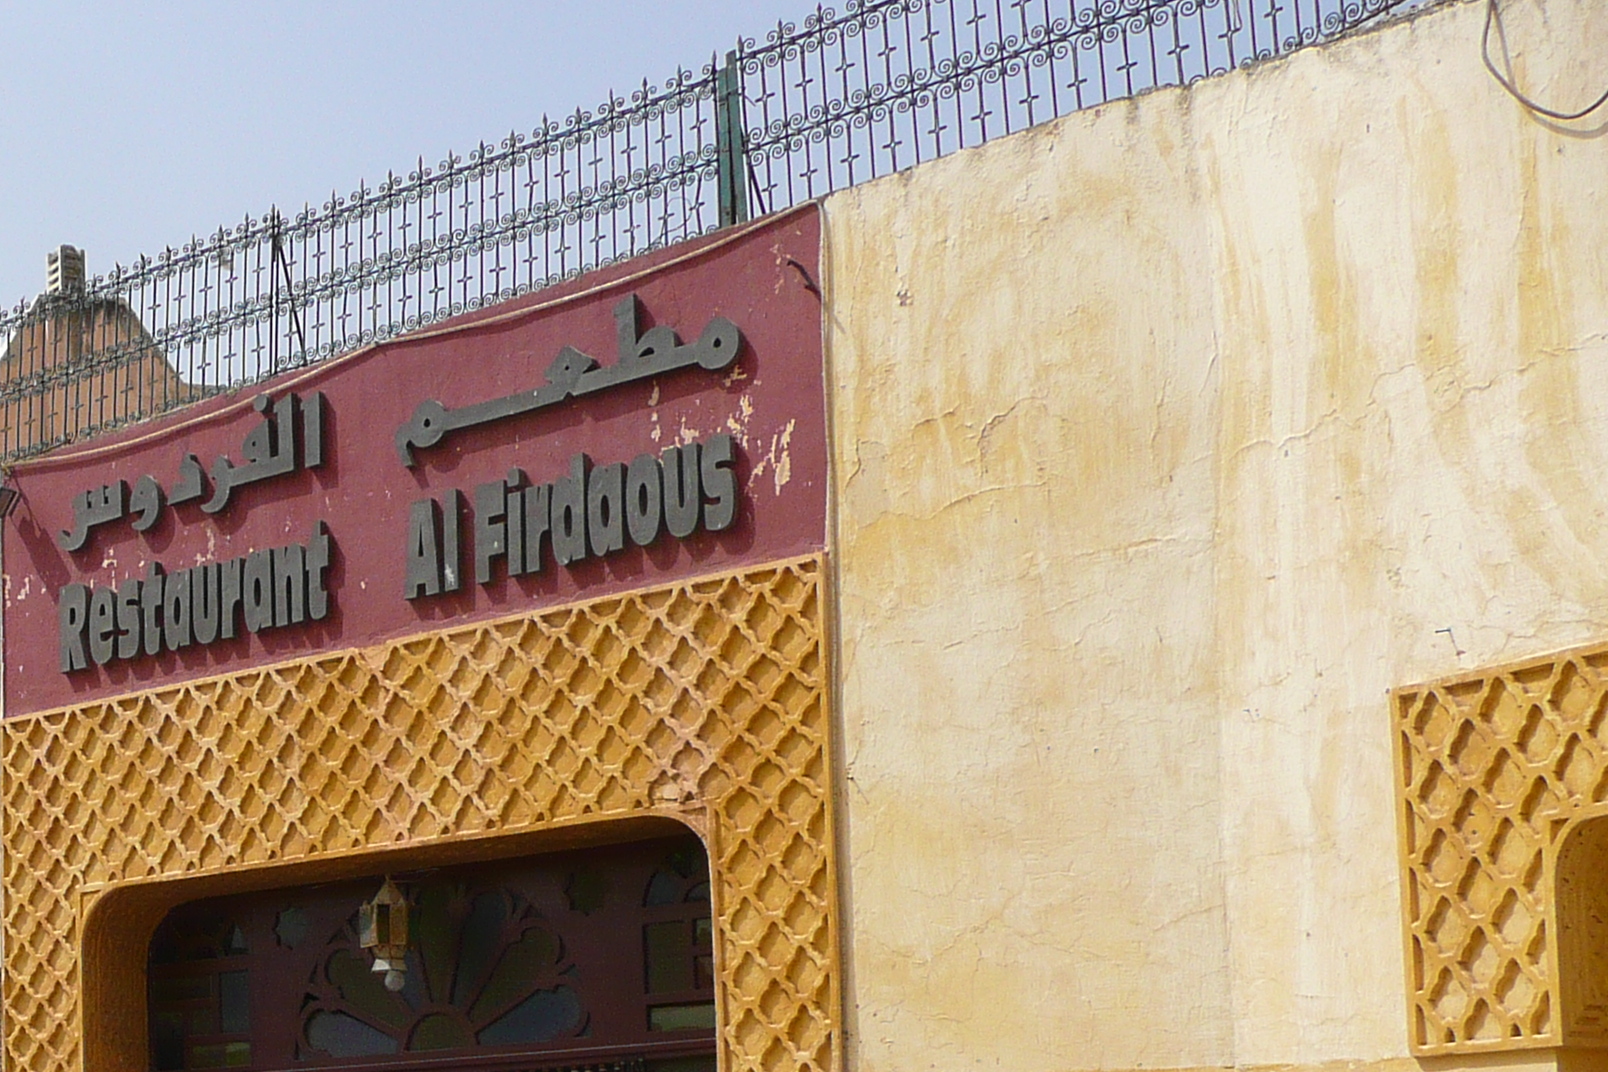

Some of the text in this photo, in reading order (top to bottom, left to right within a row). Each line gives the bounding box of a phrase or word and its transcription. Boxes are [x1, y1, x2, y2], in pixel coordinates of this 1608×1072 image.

[59, 294, 741, 552] مطعم الفردوس
[59, 434, 737, 673] Restaurant Al Firdaous
